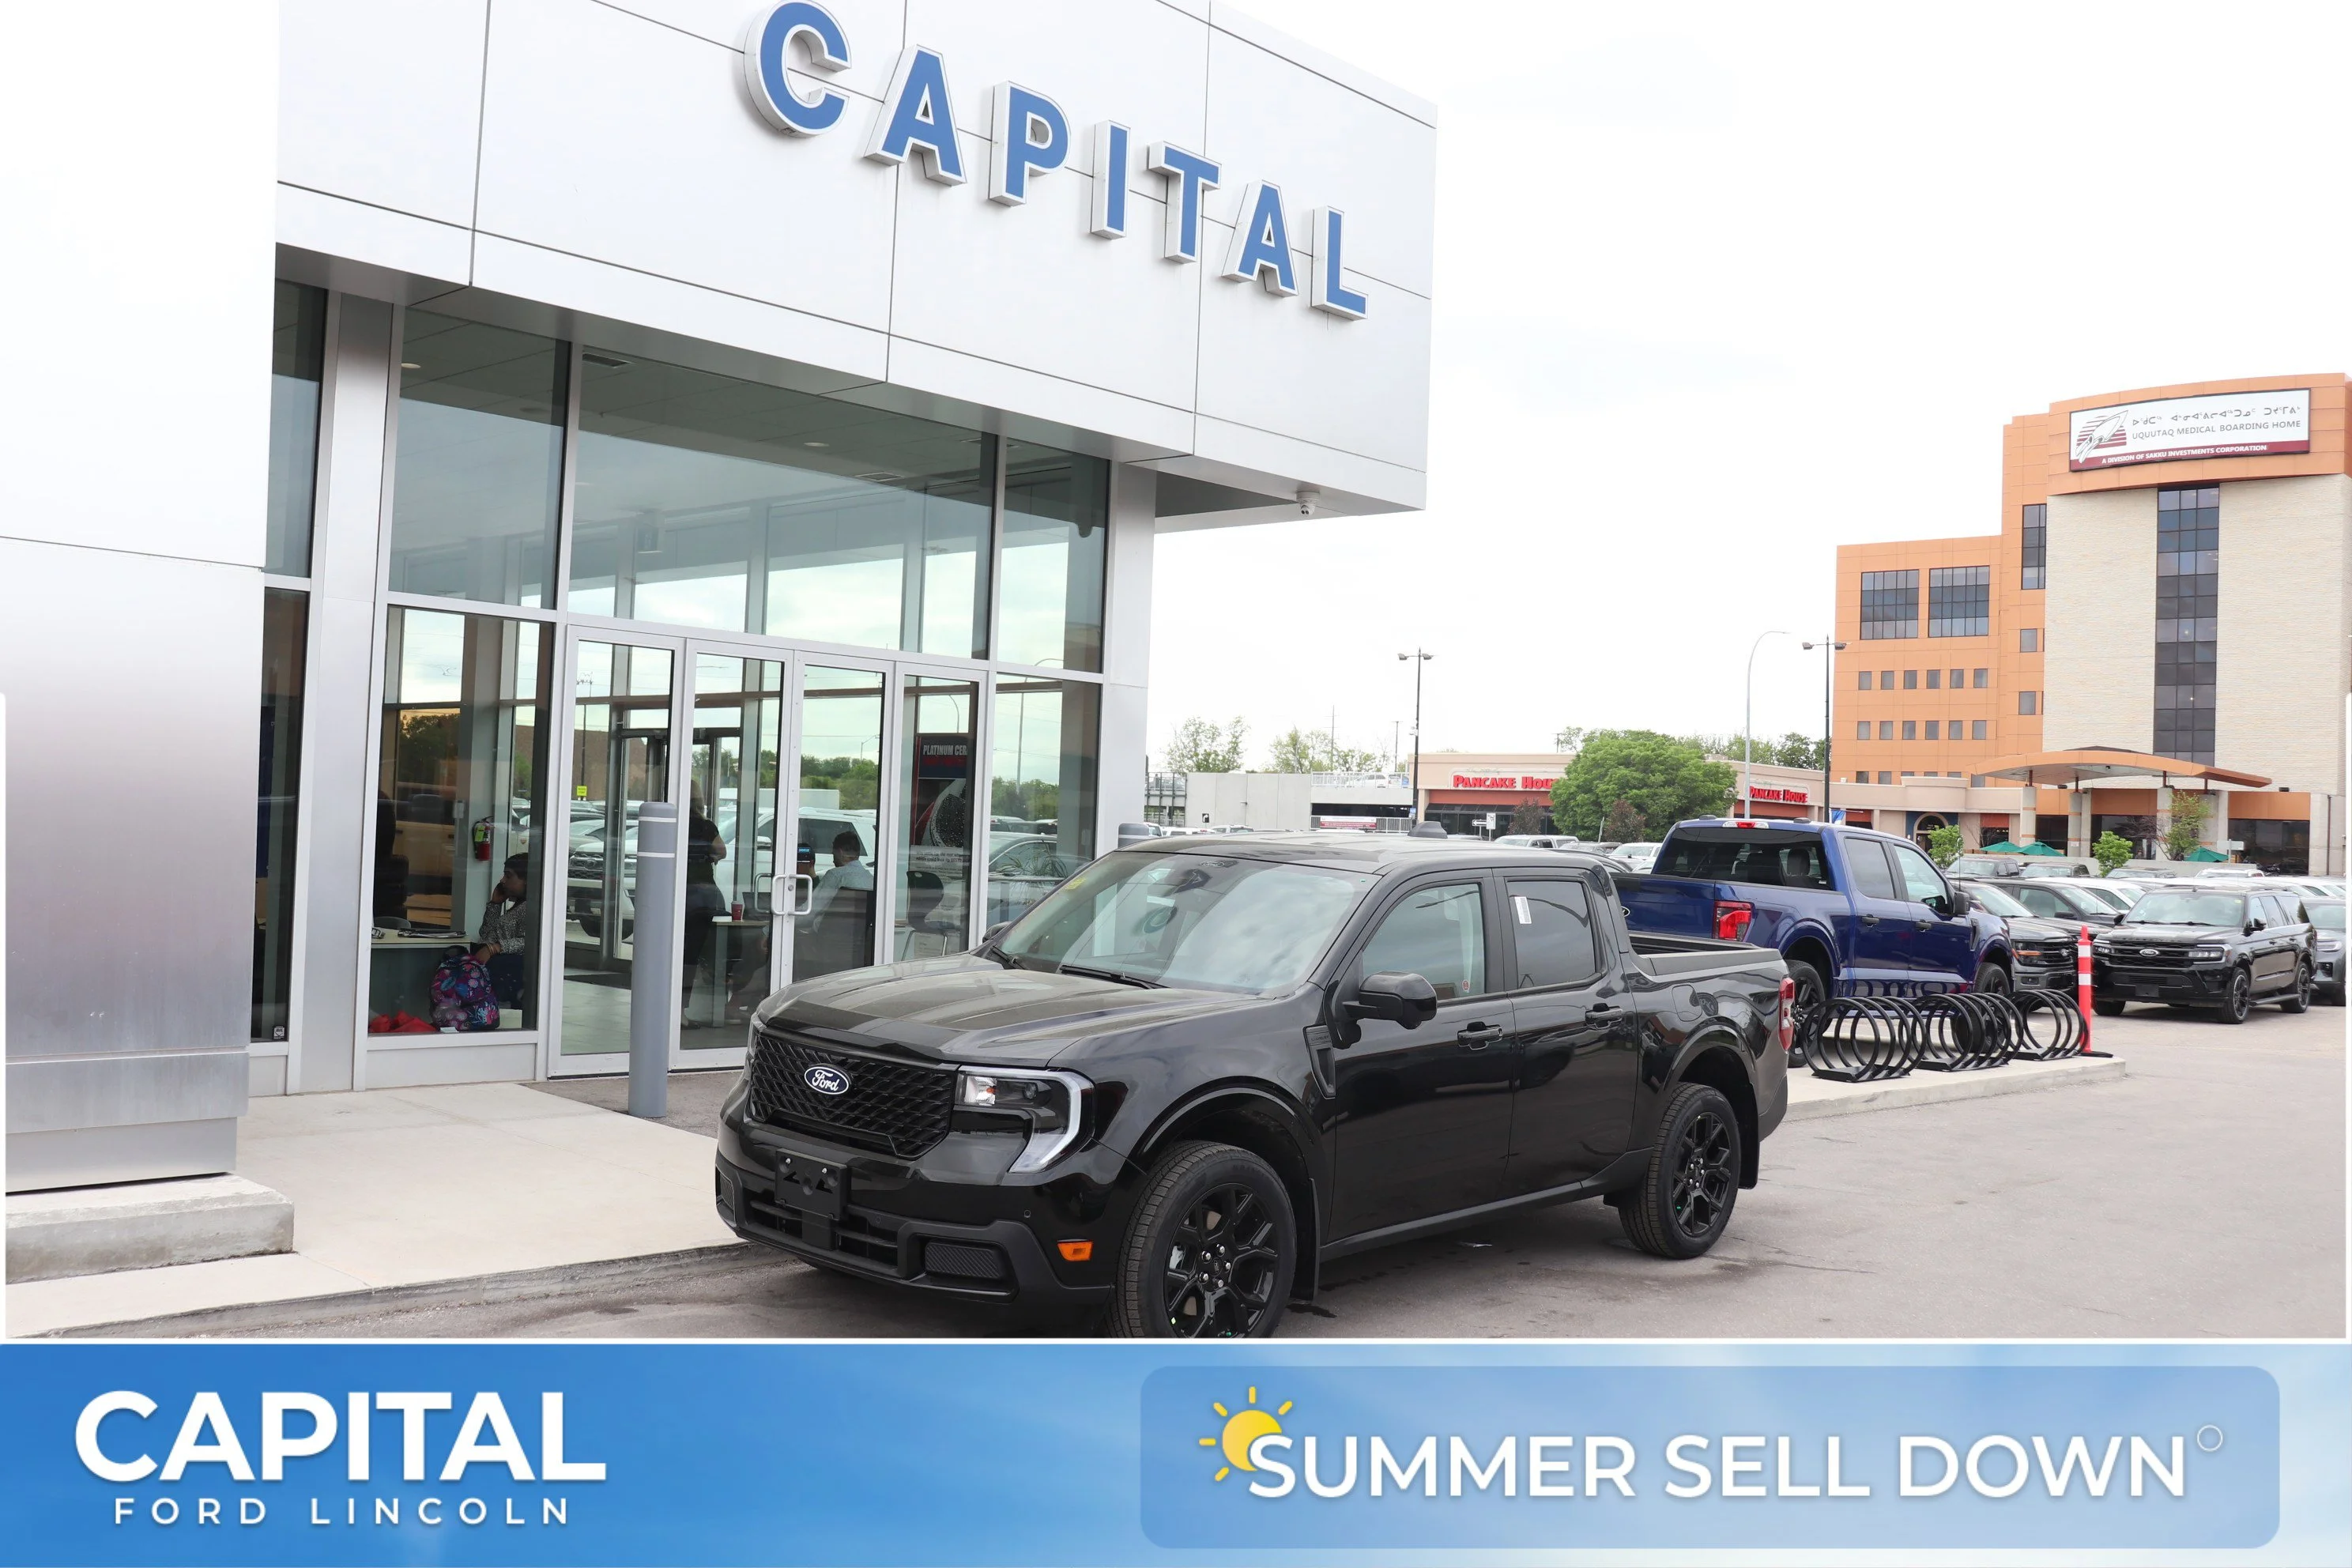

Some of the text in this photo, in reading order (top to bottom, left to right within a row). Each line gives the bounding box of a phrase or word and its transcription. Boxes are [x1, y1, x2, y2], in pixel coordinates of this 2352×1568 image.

[745, 0, 1368, 319] CAPITAL
[2132, 420, 2301, 439] UQUUTAQ MEDICAL BOARDING HOME
[2107, 454, 2135, 463] DIVISION
[2145, 450, 2167, 459] SAKKU
[2168, 447, 2214, 458] INVESTMENTS
[2215, 444, 2267, 454] CORPORATION
[922, 744, 953, 756] PLATINUM
[1453, 775, 1516, 789] PANCAKE
[1783, 789, 1807, 804] HOUSE
[811, 1069, 841, 1091] Ford
